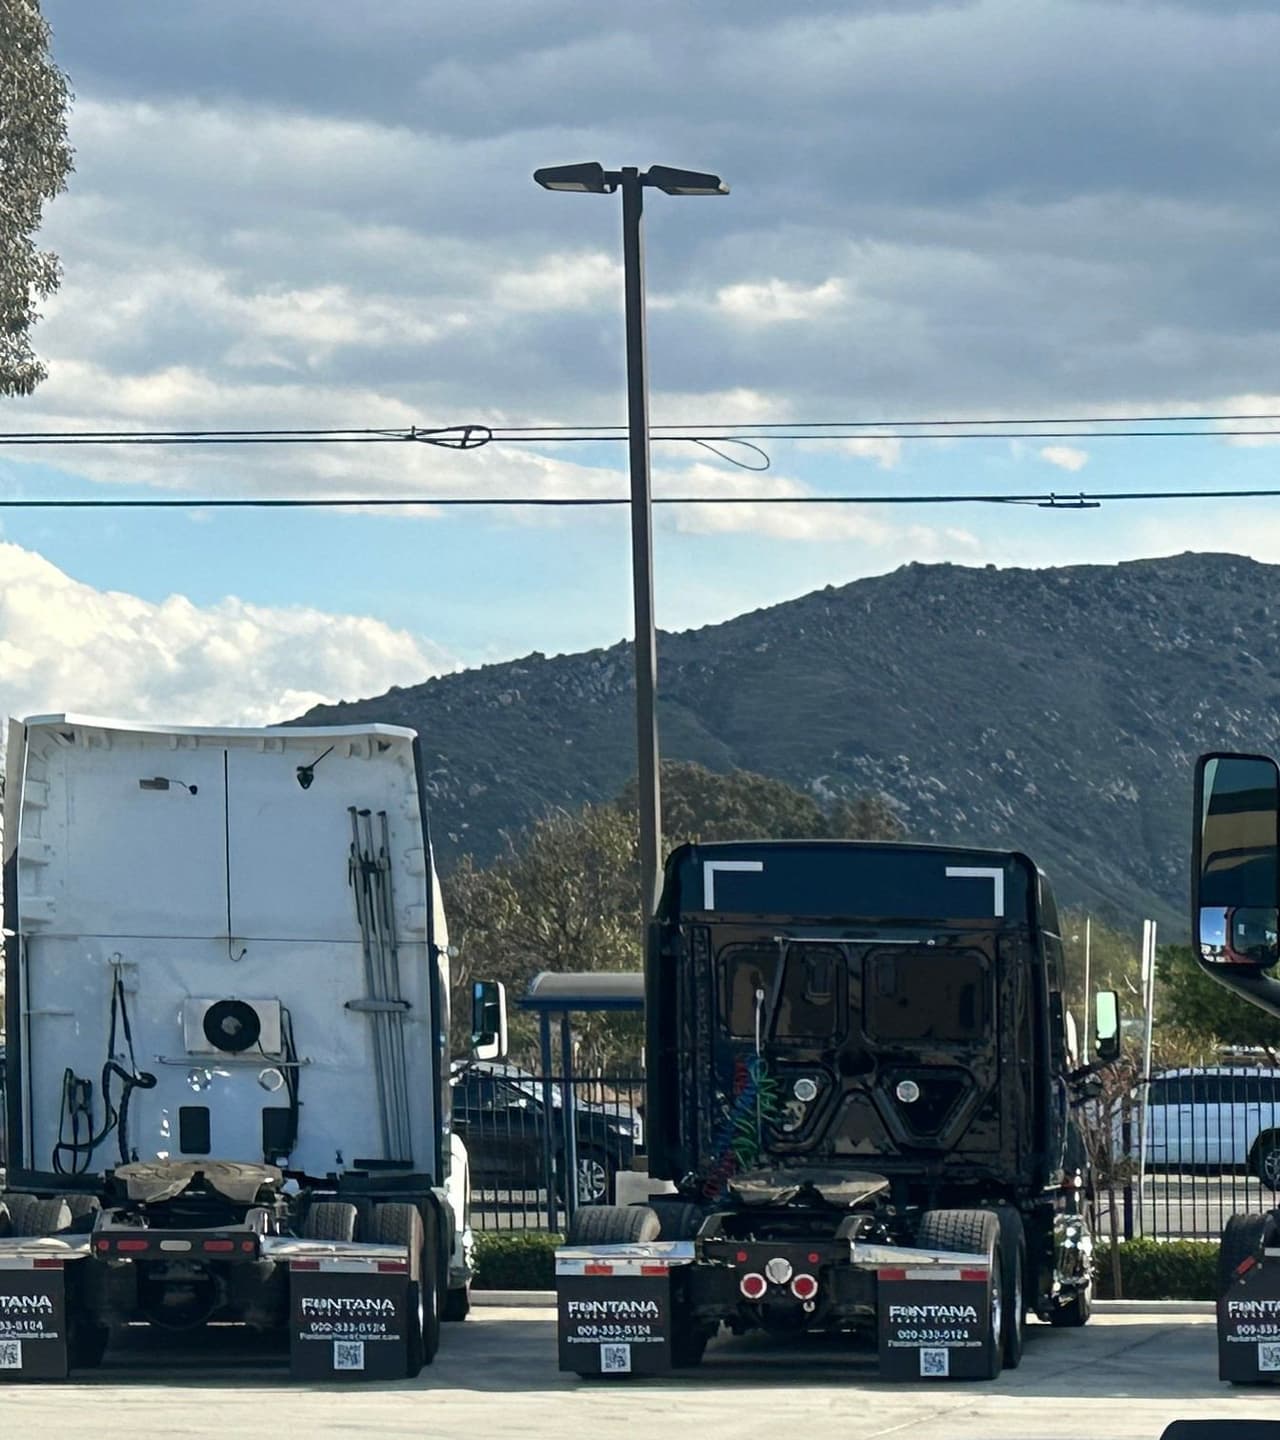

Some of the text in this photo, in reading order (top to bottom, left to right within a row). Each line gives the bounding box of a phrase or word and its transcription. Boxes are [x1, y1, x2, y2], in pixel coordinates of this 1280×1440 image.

[302, 1298, 395, 1310] FONTANA
[568, 1301, 659, 1313] FONTANA
[889, 1305, 977, 1317] FONTANA
